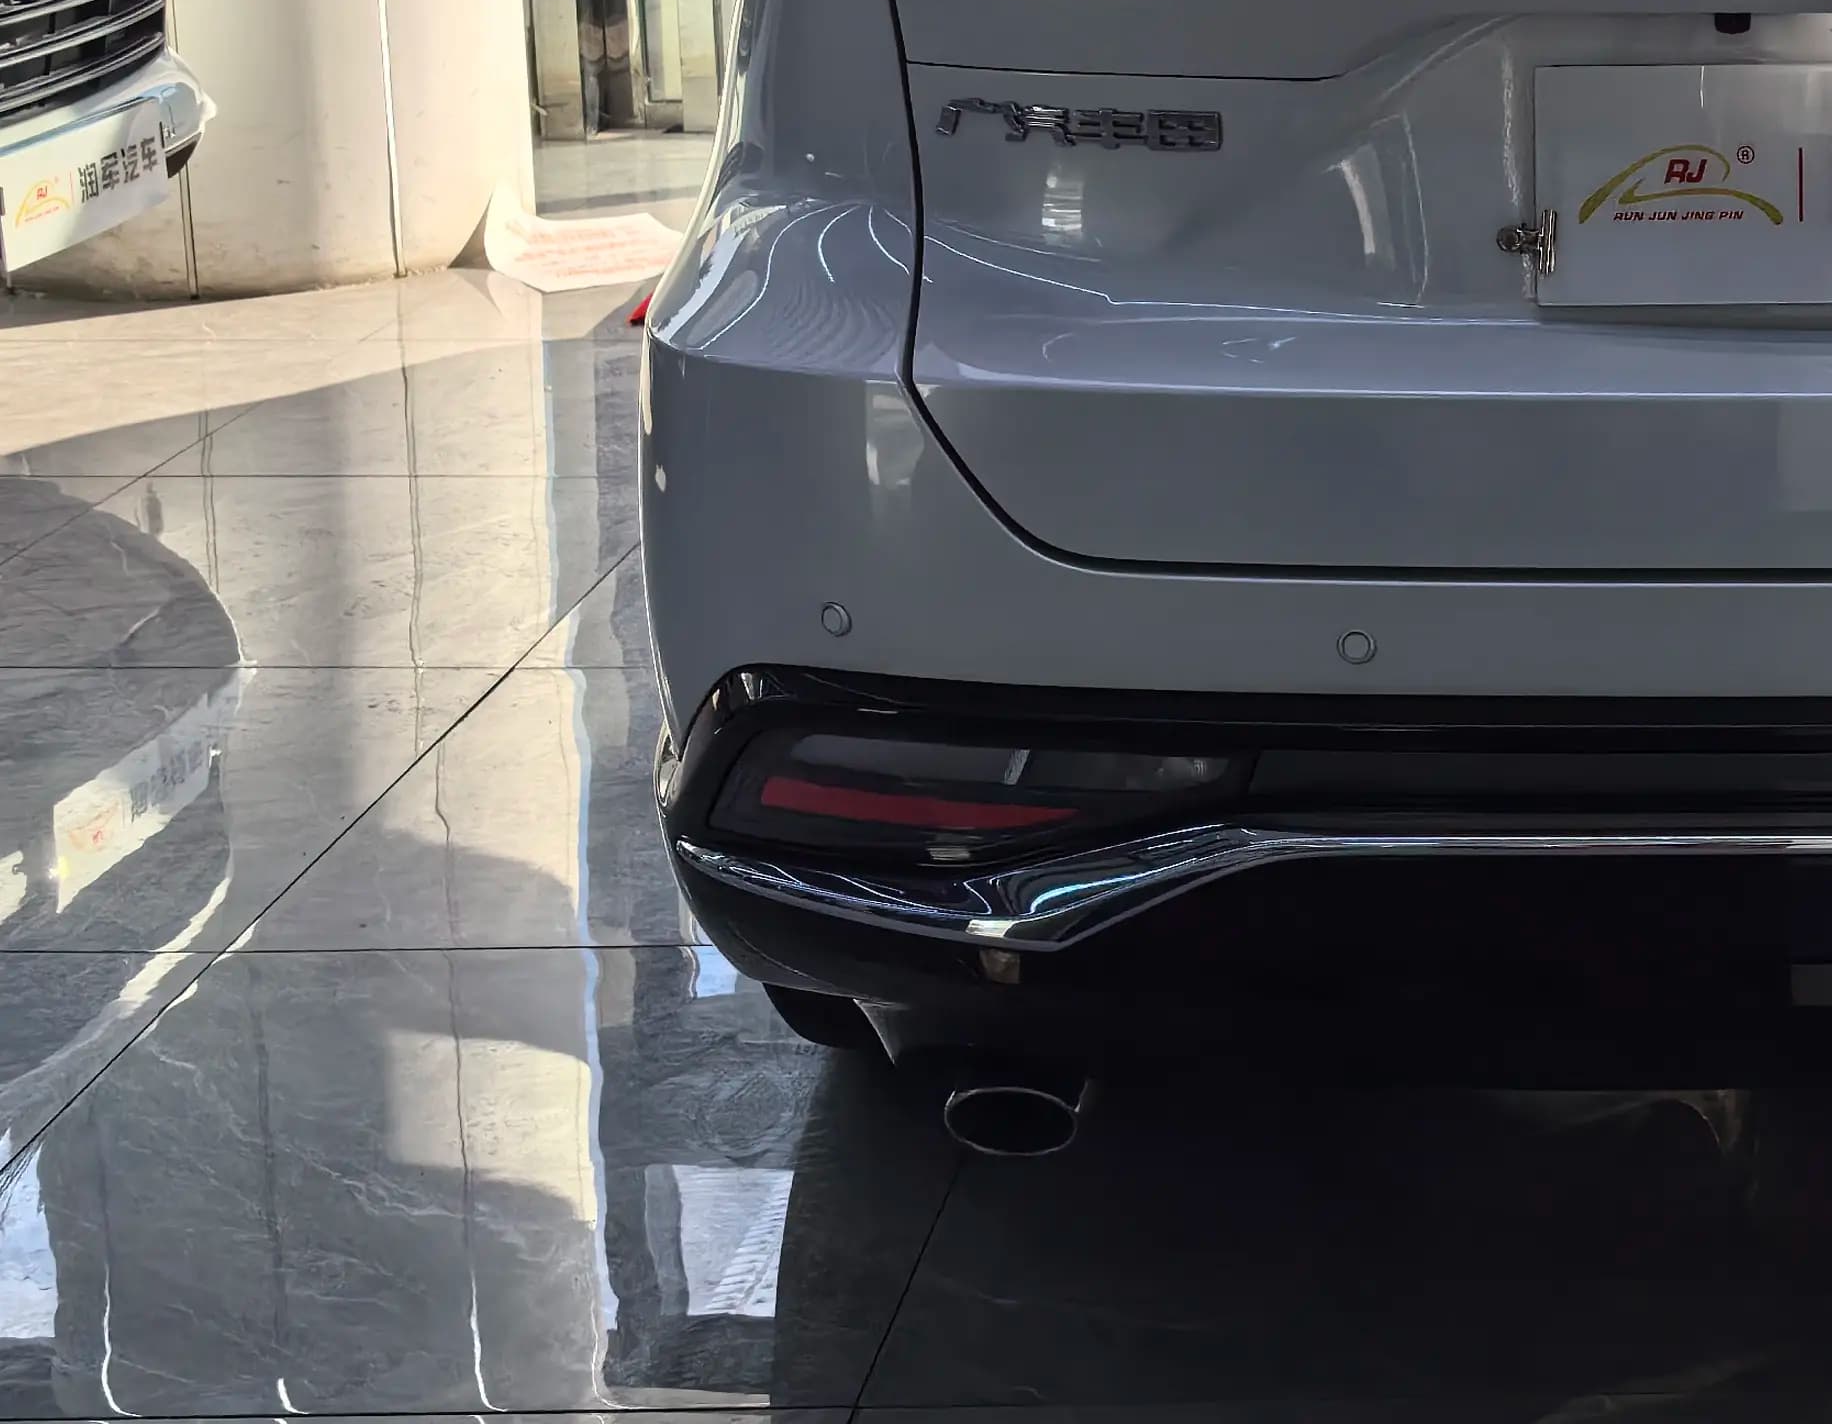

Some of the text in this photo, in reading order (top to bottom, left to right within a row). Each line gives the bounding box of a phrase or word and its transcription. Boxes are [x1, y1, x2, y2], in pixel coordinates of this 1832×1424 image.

[78, 136, 158, 203] 润军汽车
[1664, 159, 1708, 184] RJ
[1613, 210, 1744, 221] RUN JUN JING PIN
